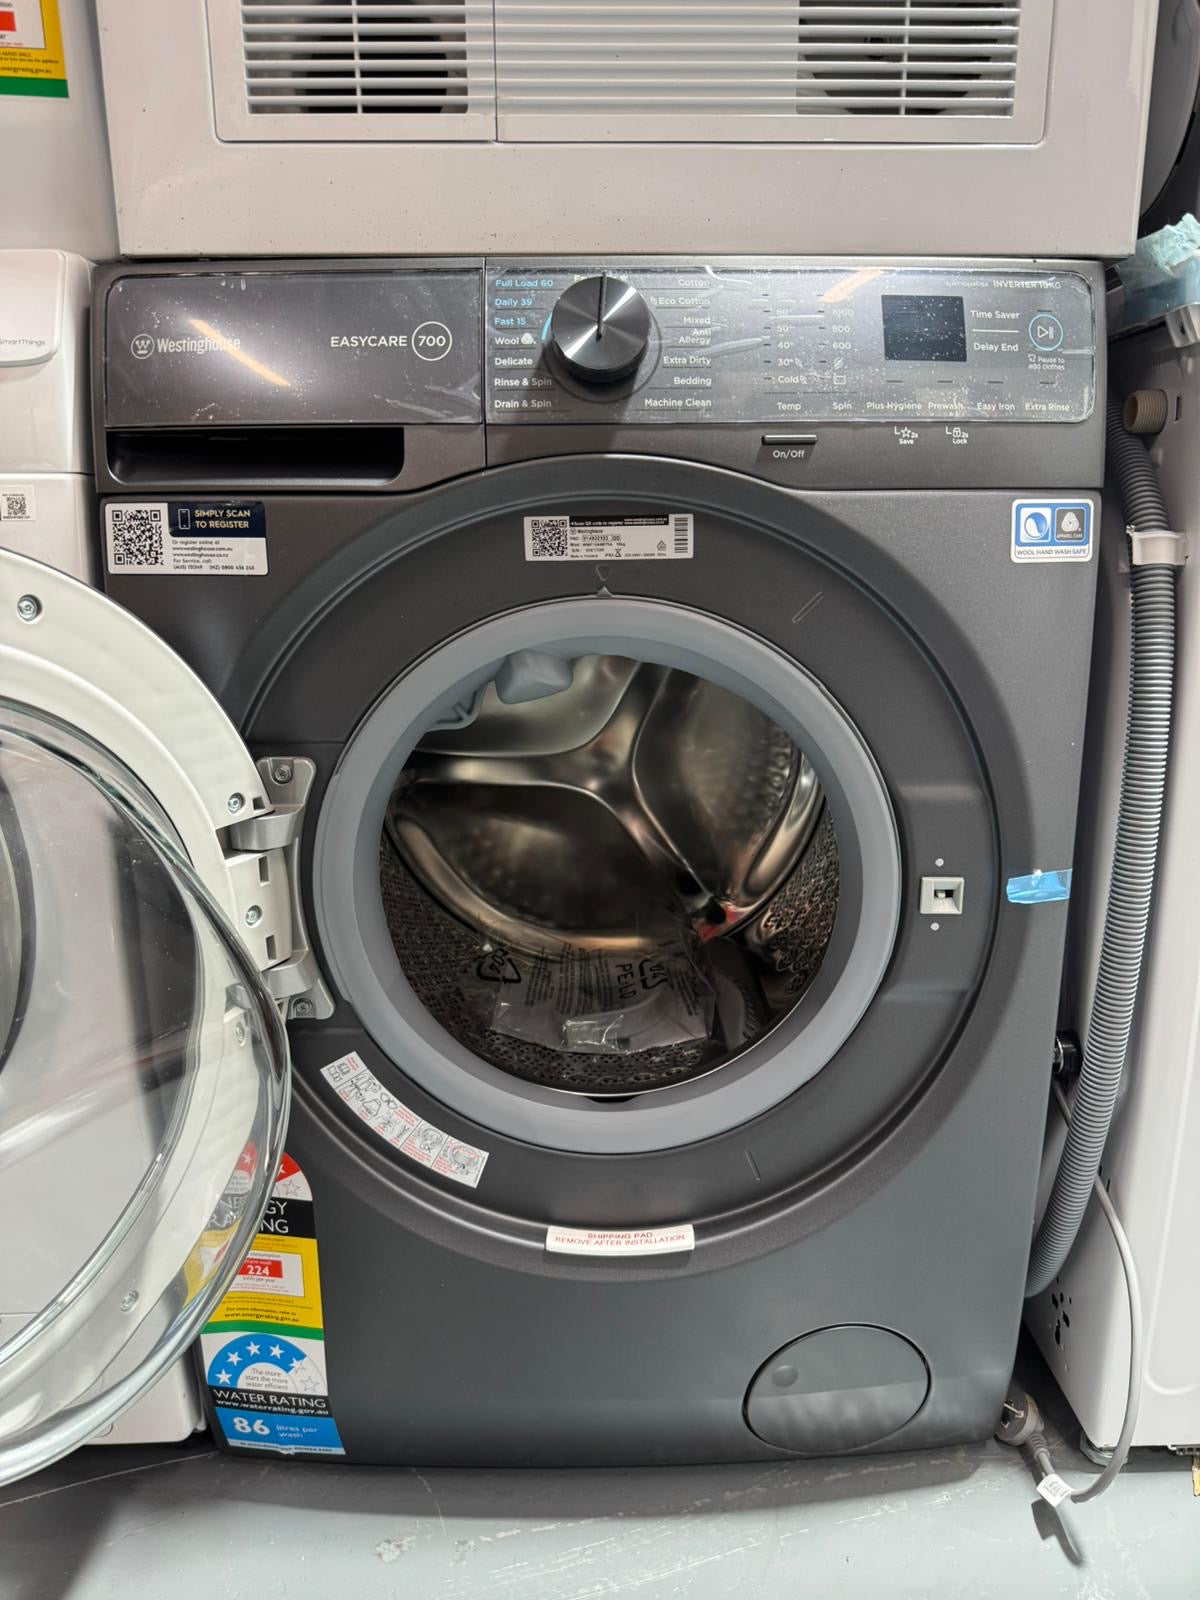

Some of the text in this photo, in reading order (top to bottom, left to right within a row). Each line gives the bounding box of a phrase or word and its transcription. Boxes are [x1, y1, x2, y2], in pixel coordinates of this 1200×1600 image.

[494, 279, 554, 288] Full Load 60
[494, 298, 533, 307] Daily 39
[658, 297, 710, 306] Eco Cotton
[970, 310, 1020, 320] Time Saver
[494, 317, 526, 326] Fast 15
[683, 316, 711, 324] Mixed
[692, 328, 712, 336] Anti
[157, 337, 241, 354] Westinghouse
[330, 335, 446, 348] EASYCARE 700
[494, 337, 520, 345] Wool
[678, 336, 711, 346] Allergy
[832, 341, 852, 350] 600
[973, 342, 1019, 352] Delay End
[494, 357, 533, 366] Delicate
[663, 356, 712, 366] Extra Dirty
[1038, 356, 1057, 364] Pause
[494, 378, 552, 388] Rinse & Spin
[673, 377, 712, 386] Bedding
[777, 375, 800, 384] Cold
[494, 400, 552, 410] Drain & Spin
[644, 398, 712, 407] Machine Clean
[777, 402, 801, 411] Temp
[832, 401, 852, 411] Spin
[976, 402, 1016, 411] Easy Iron
[1025, 402, 1070, 412] Extra Rinse
[772, 449, 804, 460] On/Off
[194, 509, 251, 518] SIMPLY SCAN
[195, 520, 250, 529] TO REGISTER
[555, 1234, 685, 1246] REMOVE AFTER INSTALLATION
[588, 1232, 631, 1240] SHIPPING
[247, 1264, 270, 1276] 224
[213, 1389, 326, 1408] WATER RATING
[216, 1400, 329, 1415] www.waterrating.gov.au
[232, 1417, 270, 1436] 86
[276, 1424, 319, 1434] litres per
